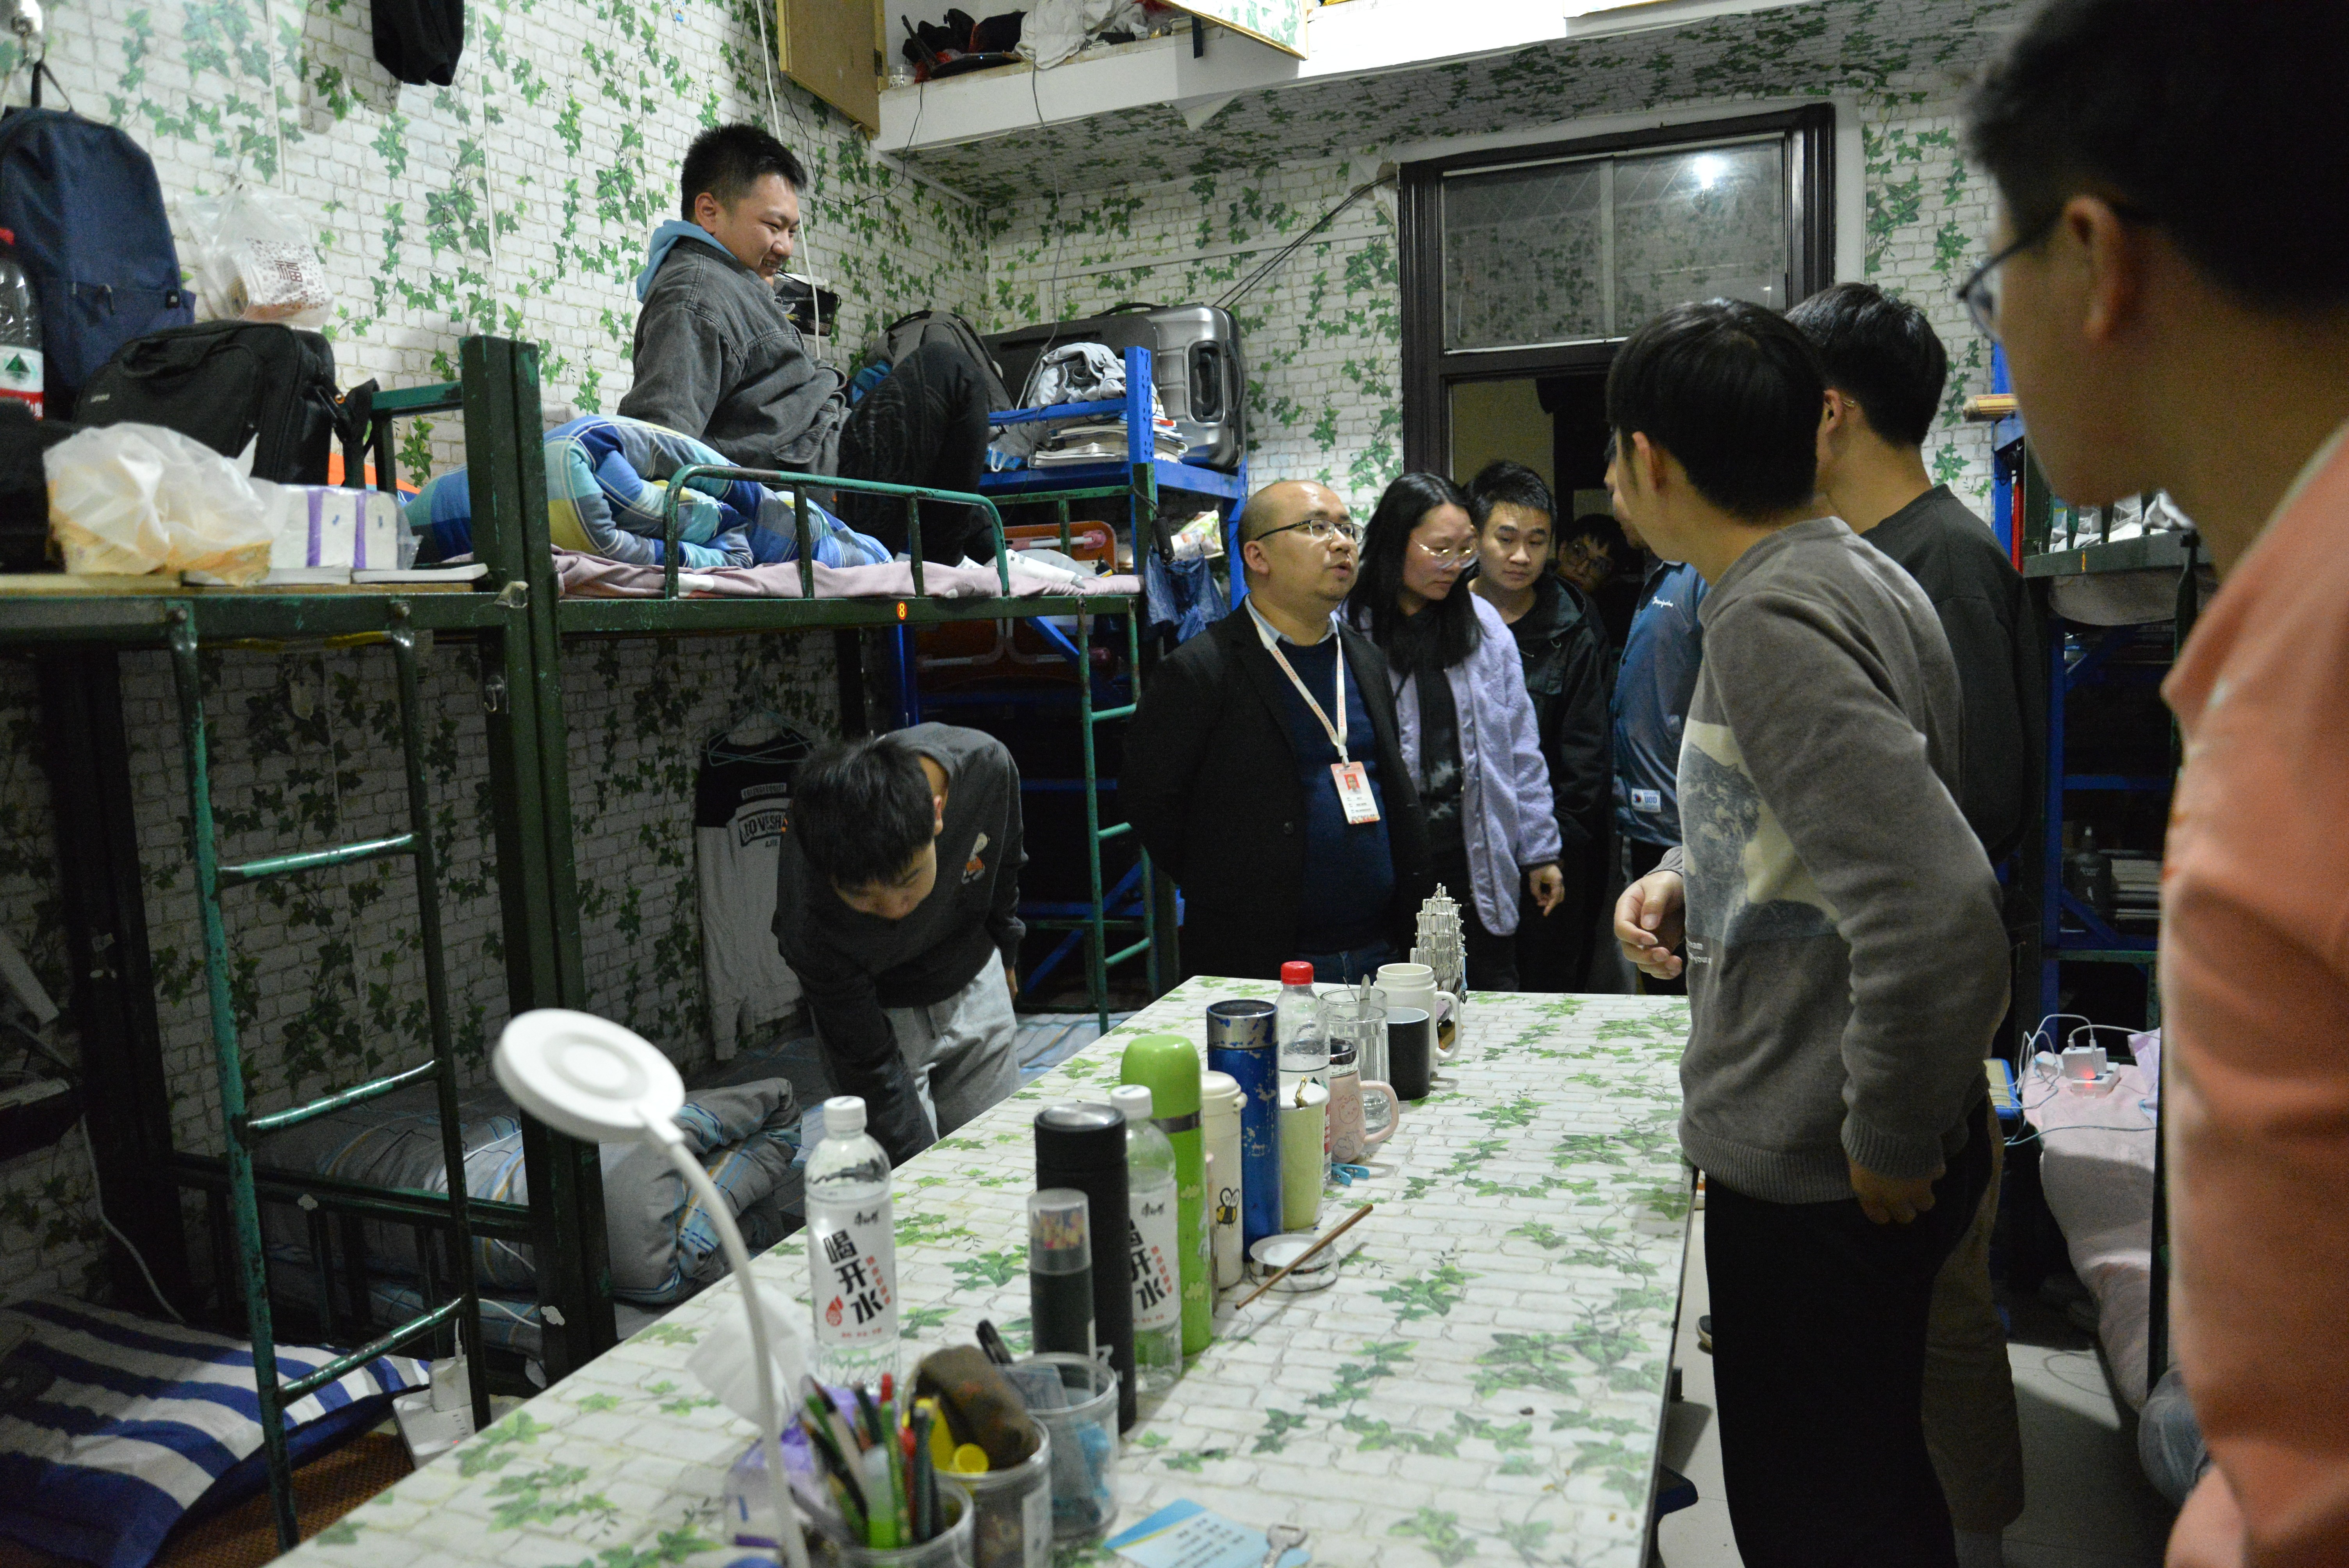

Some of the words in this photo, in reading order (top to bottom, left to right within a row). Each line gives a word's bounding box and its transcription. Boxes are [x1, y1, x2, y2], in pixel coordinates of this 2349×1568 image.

[274, 260, 303, 283] 福
[899, 603, 905, 617] 8
[823, 1228, 883, 1324] 喝开水
